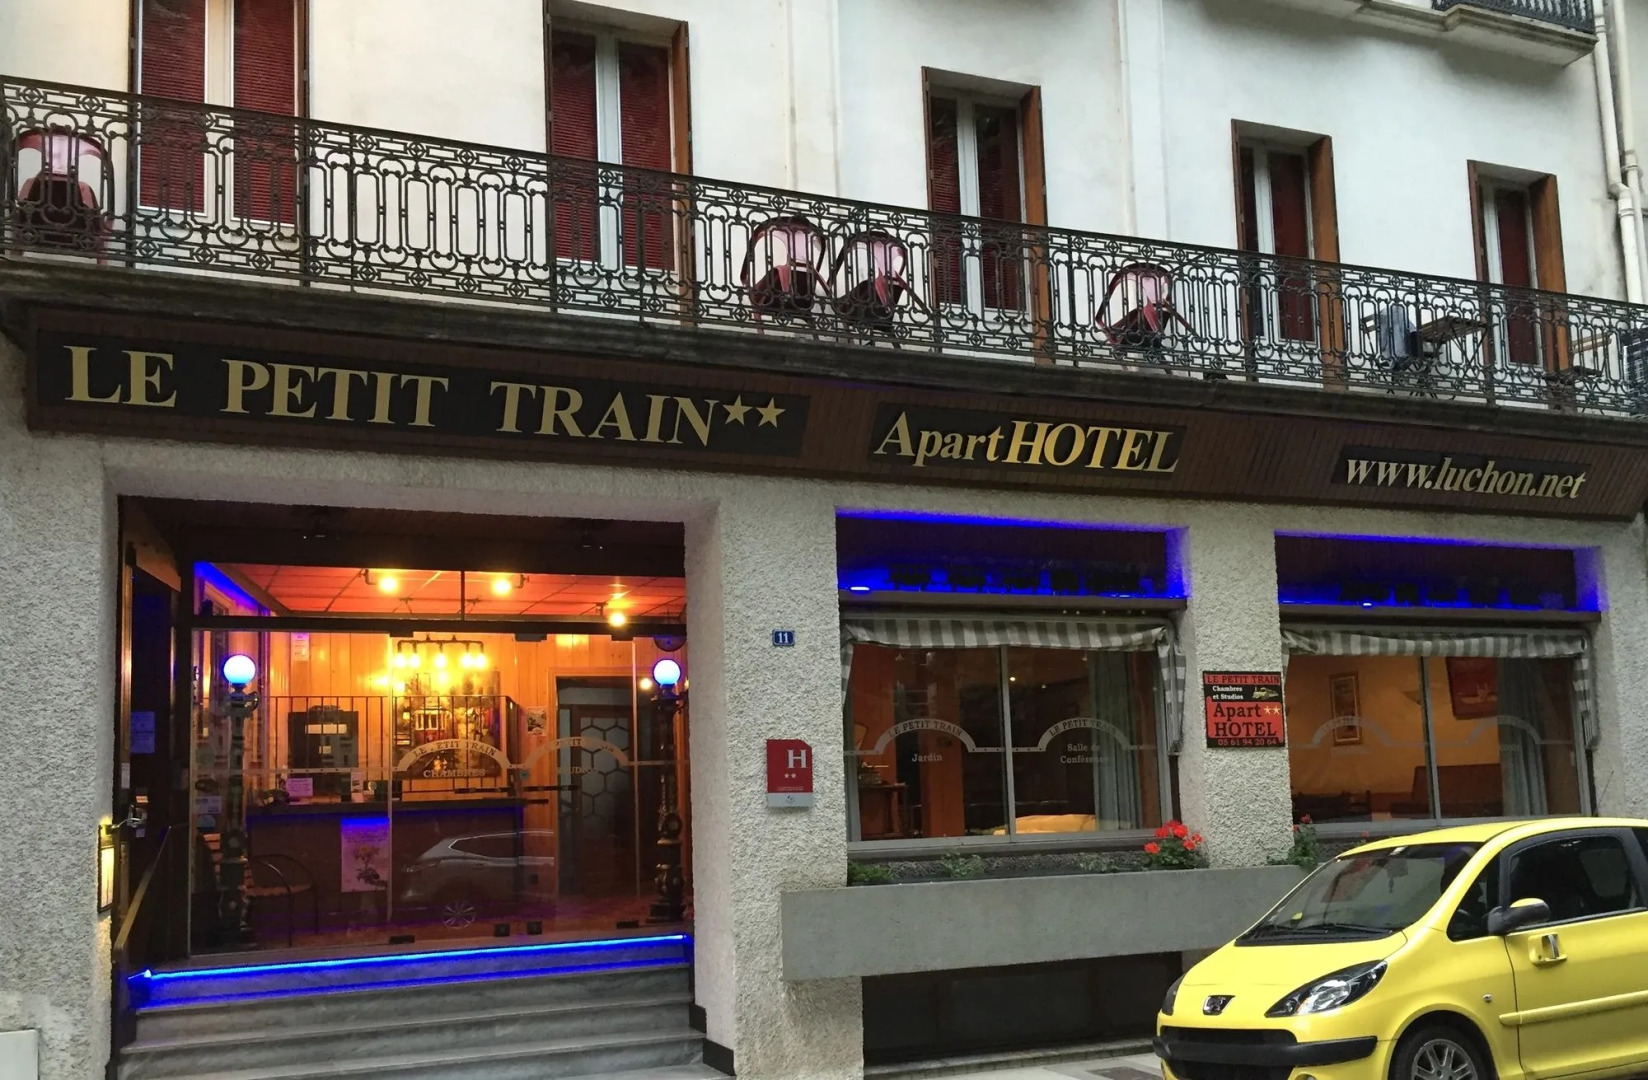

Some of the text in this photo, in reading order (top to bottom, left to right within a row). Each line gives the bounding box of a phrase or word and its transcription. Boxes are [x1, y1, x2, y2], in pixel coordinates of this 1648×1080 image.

[64, 345, 718, 447] LE PETIT TRAIN
[1345, 455, 1587, 500] www.luchon.net
[777, 632, 789, 643] 11
[1213, 703, 1262, 721] Apart
[902, 720, 929, 731] PETIT
[934, 720, 963, 736] TRAIN
[1049, 725, 1061, 736] LE
[1062, 719, 1087, 730] PETIT
[1214, 722, 1277, 737] HOTEL
[1067, 743, 1088, 752] Salle
[787, 749, 807, 768] H
[911, 753, 943, 762] Jardin
[423, 768, 486, 779] CHAMBRES
